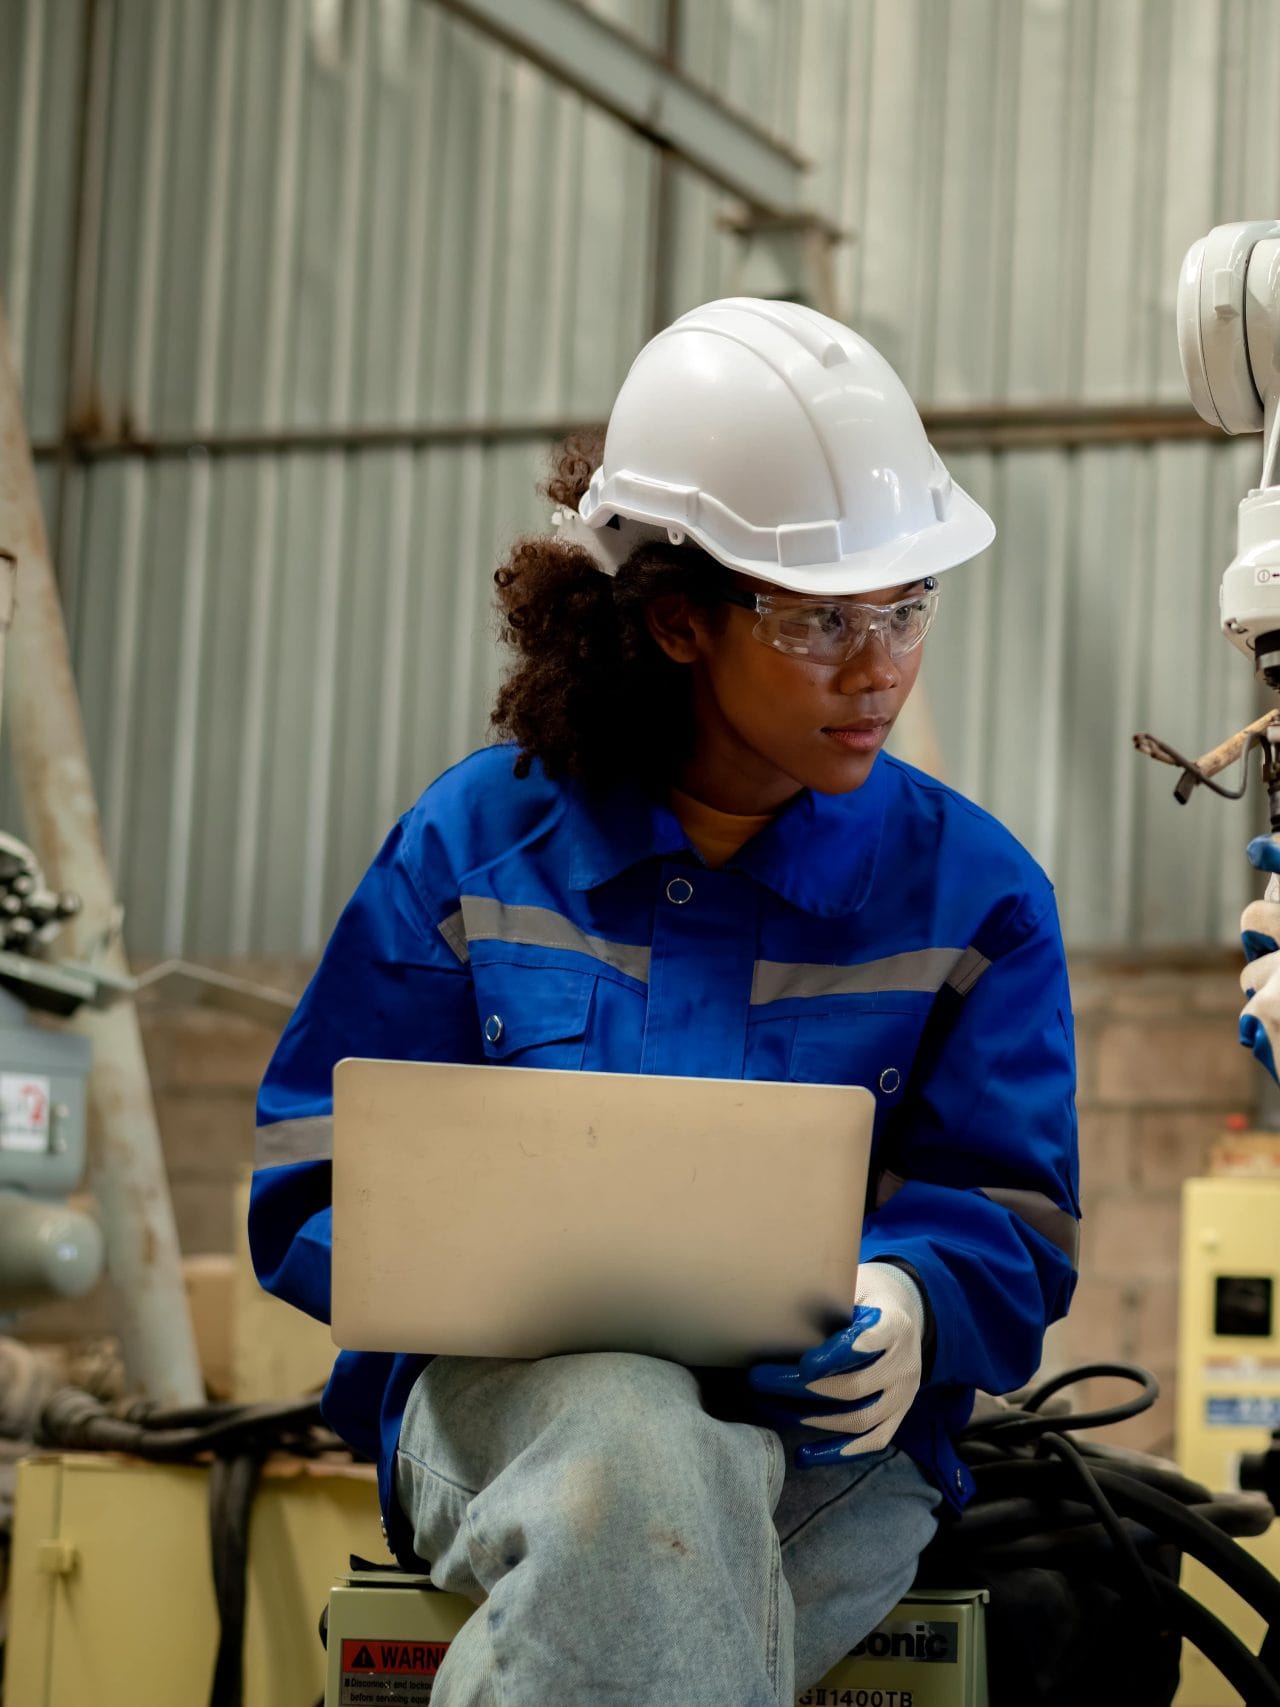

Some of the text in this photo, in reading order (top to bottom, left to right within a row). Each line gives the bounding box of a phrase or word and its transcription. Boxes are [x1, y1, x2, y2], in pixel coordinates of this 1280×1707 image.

[351, 1678, 432, 1690] Disconnect and lockou
[350, 1692, 373, 1702] before
[376, 1693, 408, 1704] servicing
